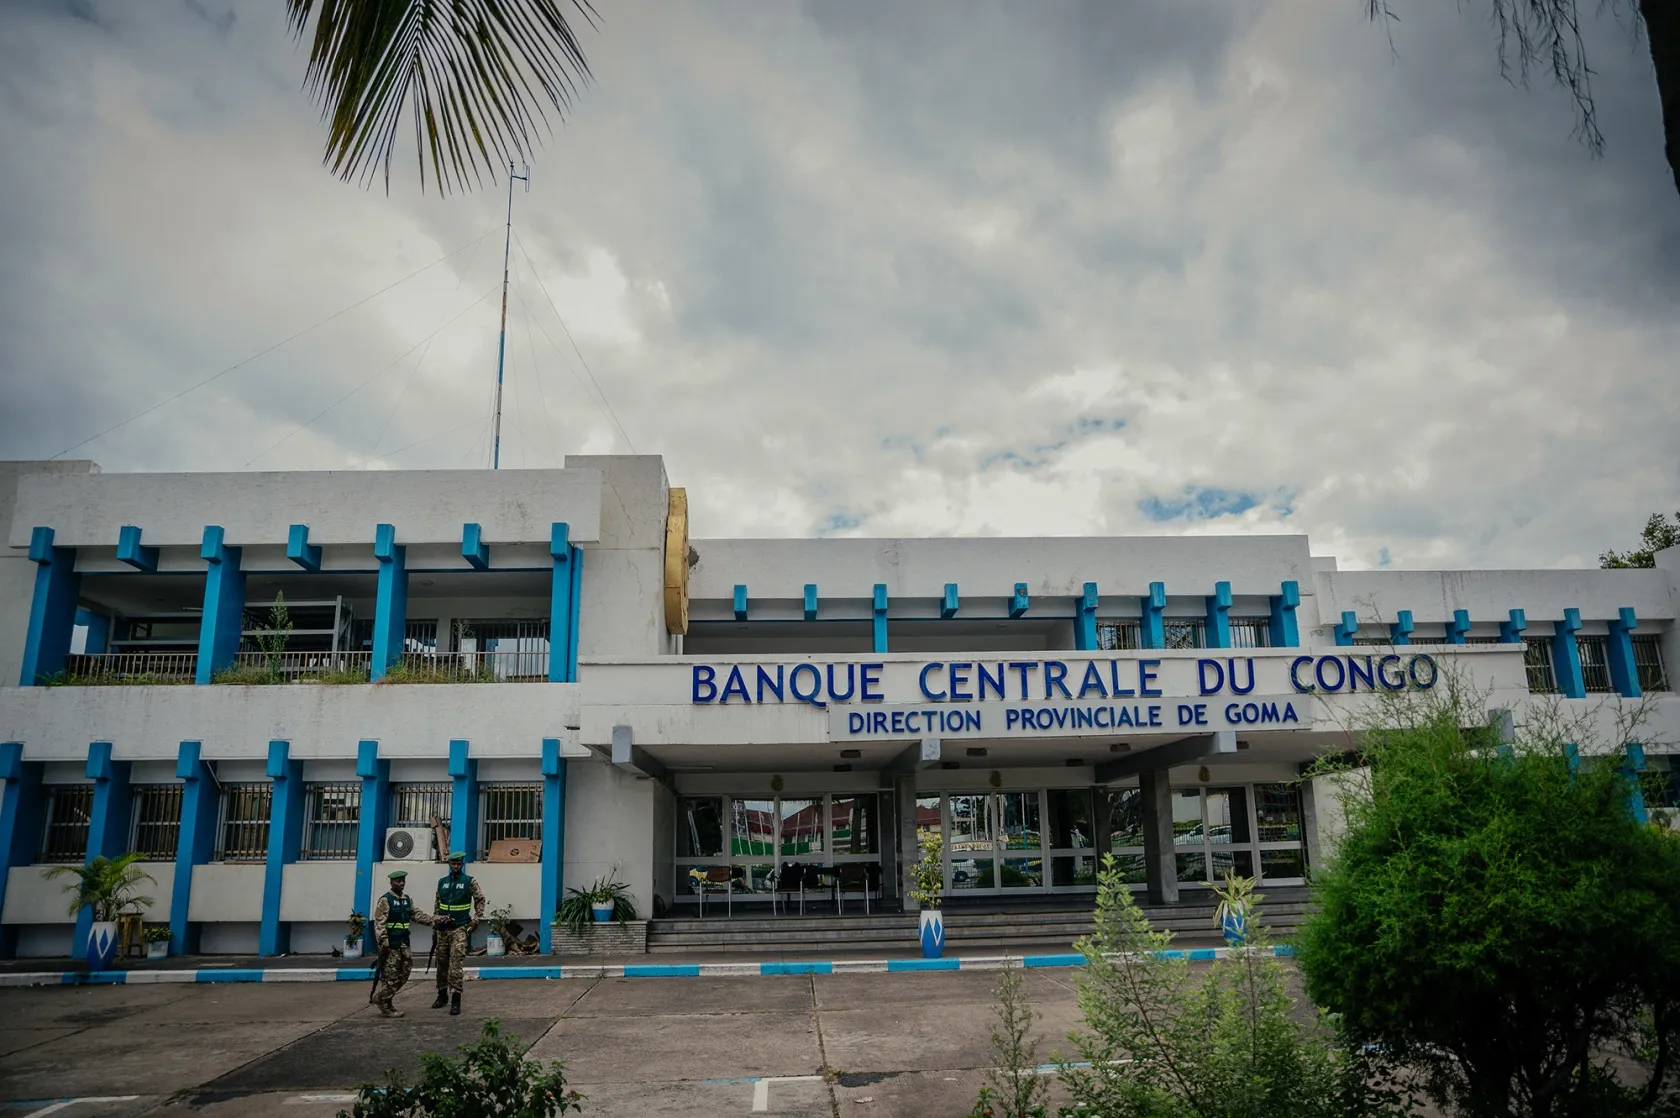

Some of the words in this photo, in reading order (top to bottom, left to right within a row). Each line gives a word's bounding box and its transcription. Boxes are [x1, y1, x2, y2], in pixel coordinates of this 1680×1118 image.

[693, 663, 884, 707] BANQUE
[920, 660, 1163, 702] CENTRALE
[1198, 657, 1255, 696] DU
[1291, 654, 1438, 693] CONGO
[849, 710, 982, 734] DIRECTION
[1005, 707, 1162, 729] PROVINCIALE
[1178, 704, 1208, 726] DE
[1225, 702, 1299, 725] GOMA
